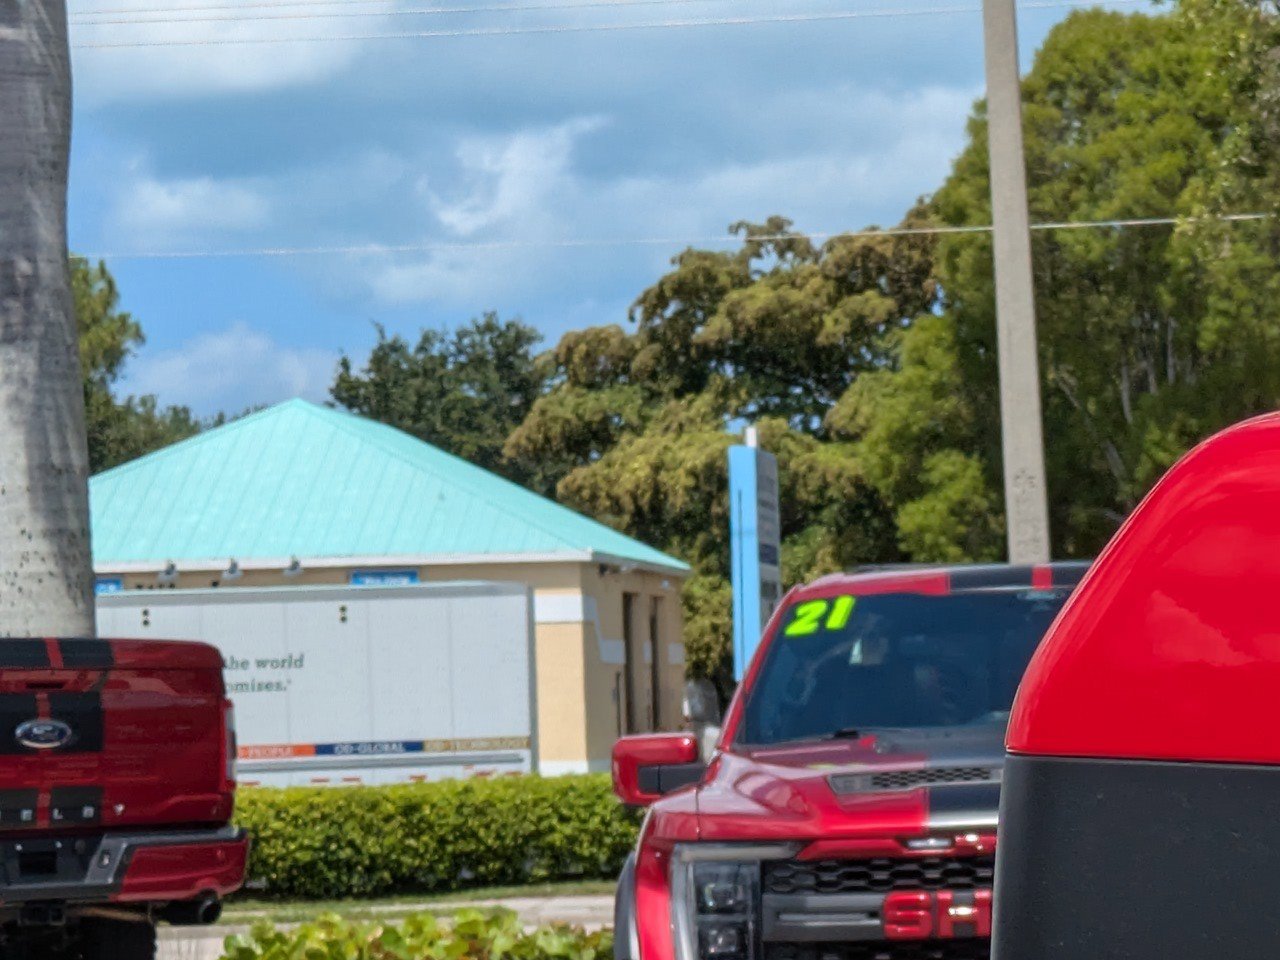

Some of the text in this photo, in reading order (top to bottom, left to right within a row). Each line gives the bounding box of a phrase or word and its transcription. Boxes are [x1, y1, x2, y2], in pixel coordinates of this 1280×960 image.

[785, 595, 856, 635] 21
[254, 653, 304, 669] world
[0, 803, 125, 822] ELBY
[883, 889, 991, 939] SH
